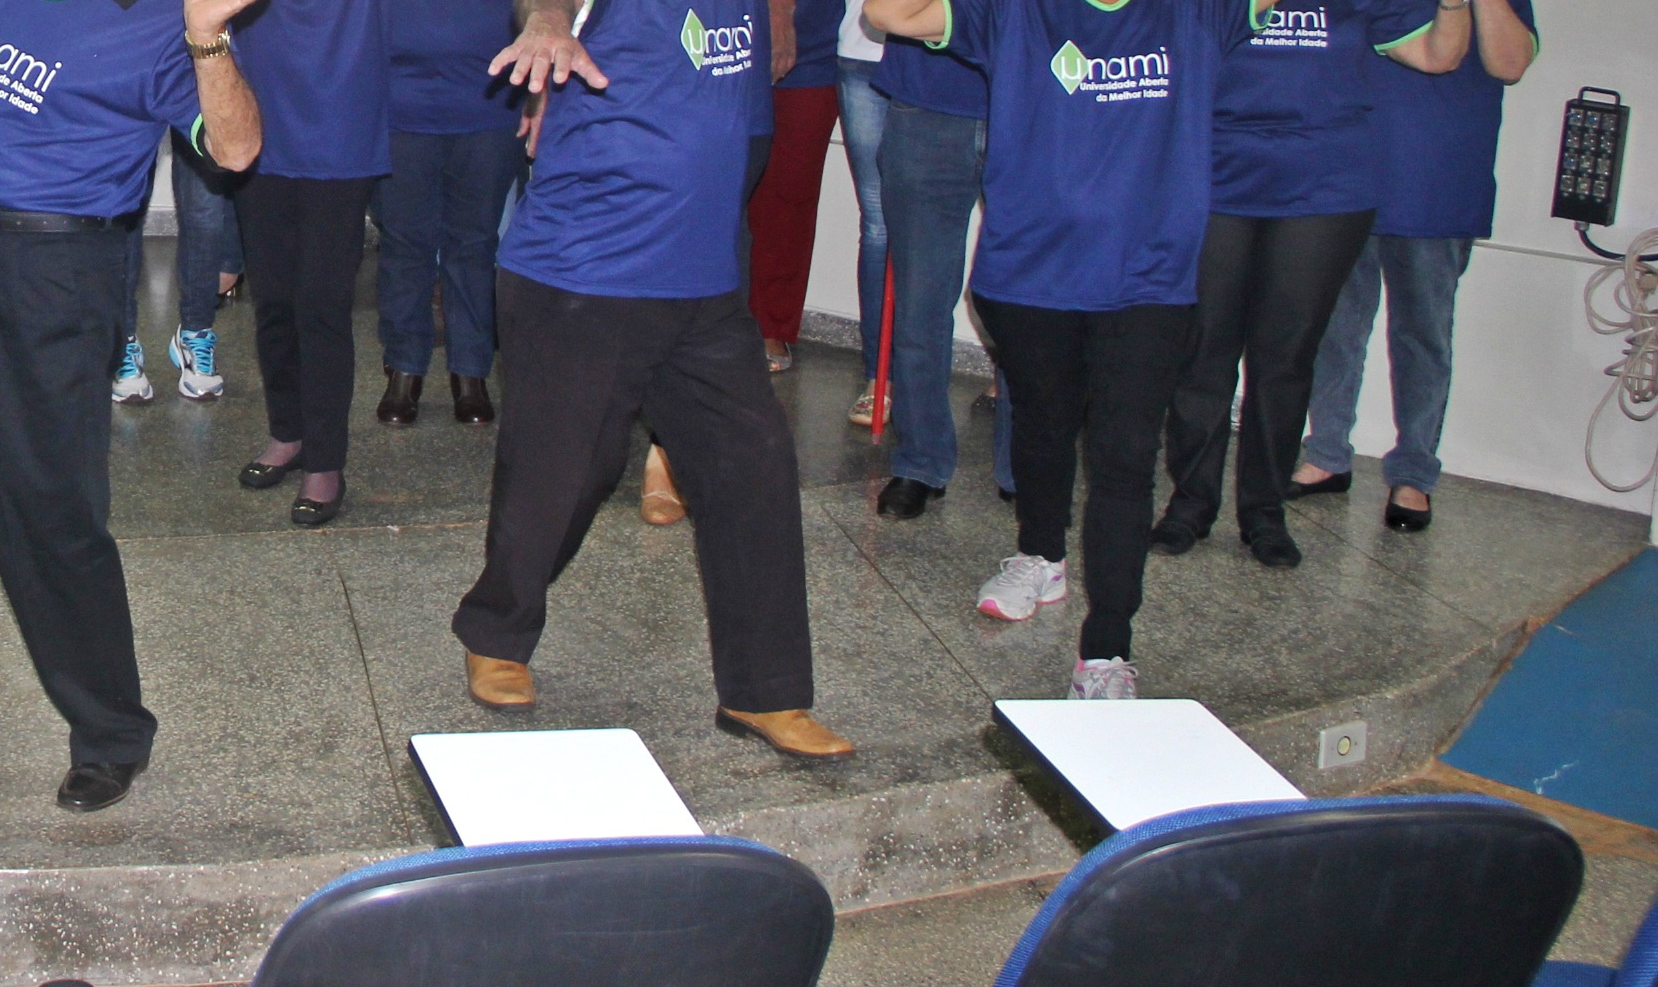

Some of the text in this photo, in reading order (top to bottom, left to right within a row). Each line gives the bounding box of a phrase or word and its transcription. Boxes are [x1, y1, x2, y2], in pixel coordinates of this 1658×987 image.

[1295, 28, 1328, 38] Aberta
[1250, 37, 1328, 48] da Melhor Idade
[1079, 76, 1170, 92] Universidade Aberta
[10, 80, 44, 104] Aberta
[1095, 88, 1169, 103] da Melhor Idade
[8, 93, 39, 115] Idade
